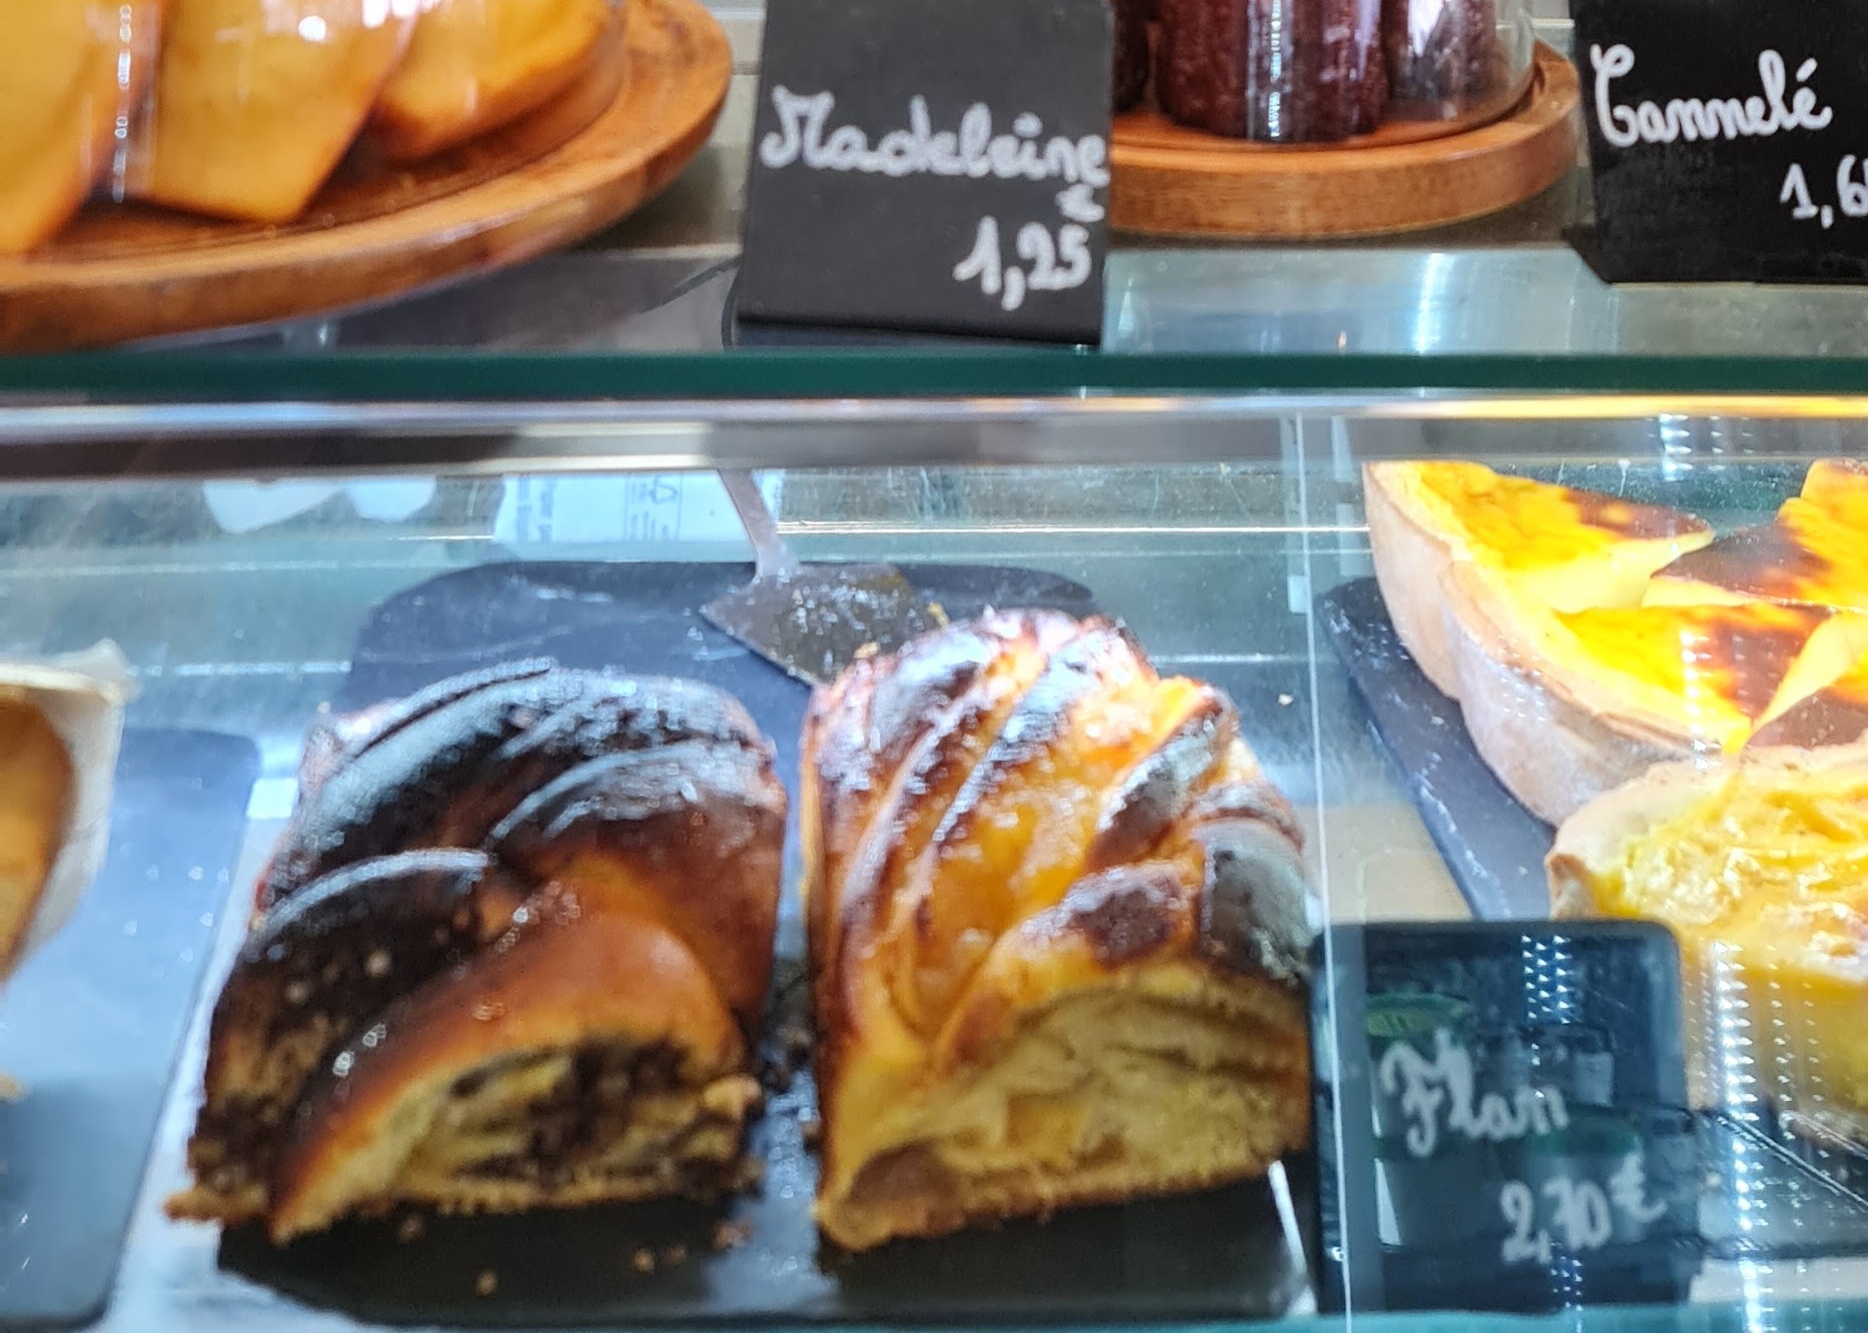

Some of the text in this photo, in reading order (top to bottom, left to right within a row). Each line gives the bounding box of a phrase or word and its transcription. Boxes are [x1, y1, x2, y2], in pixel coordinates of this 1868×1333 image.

[759, 84, 1110, 188] Madeleine
[1590, 43, 1833, 148] Cannelé
[1779, 153, 1868, 229] 1,6
[1380, 1027, 1570, 1157] Flan
